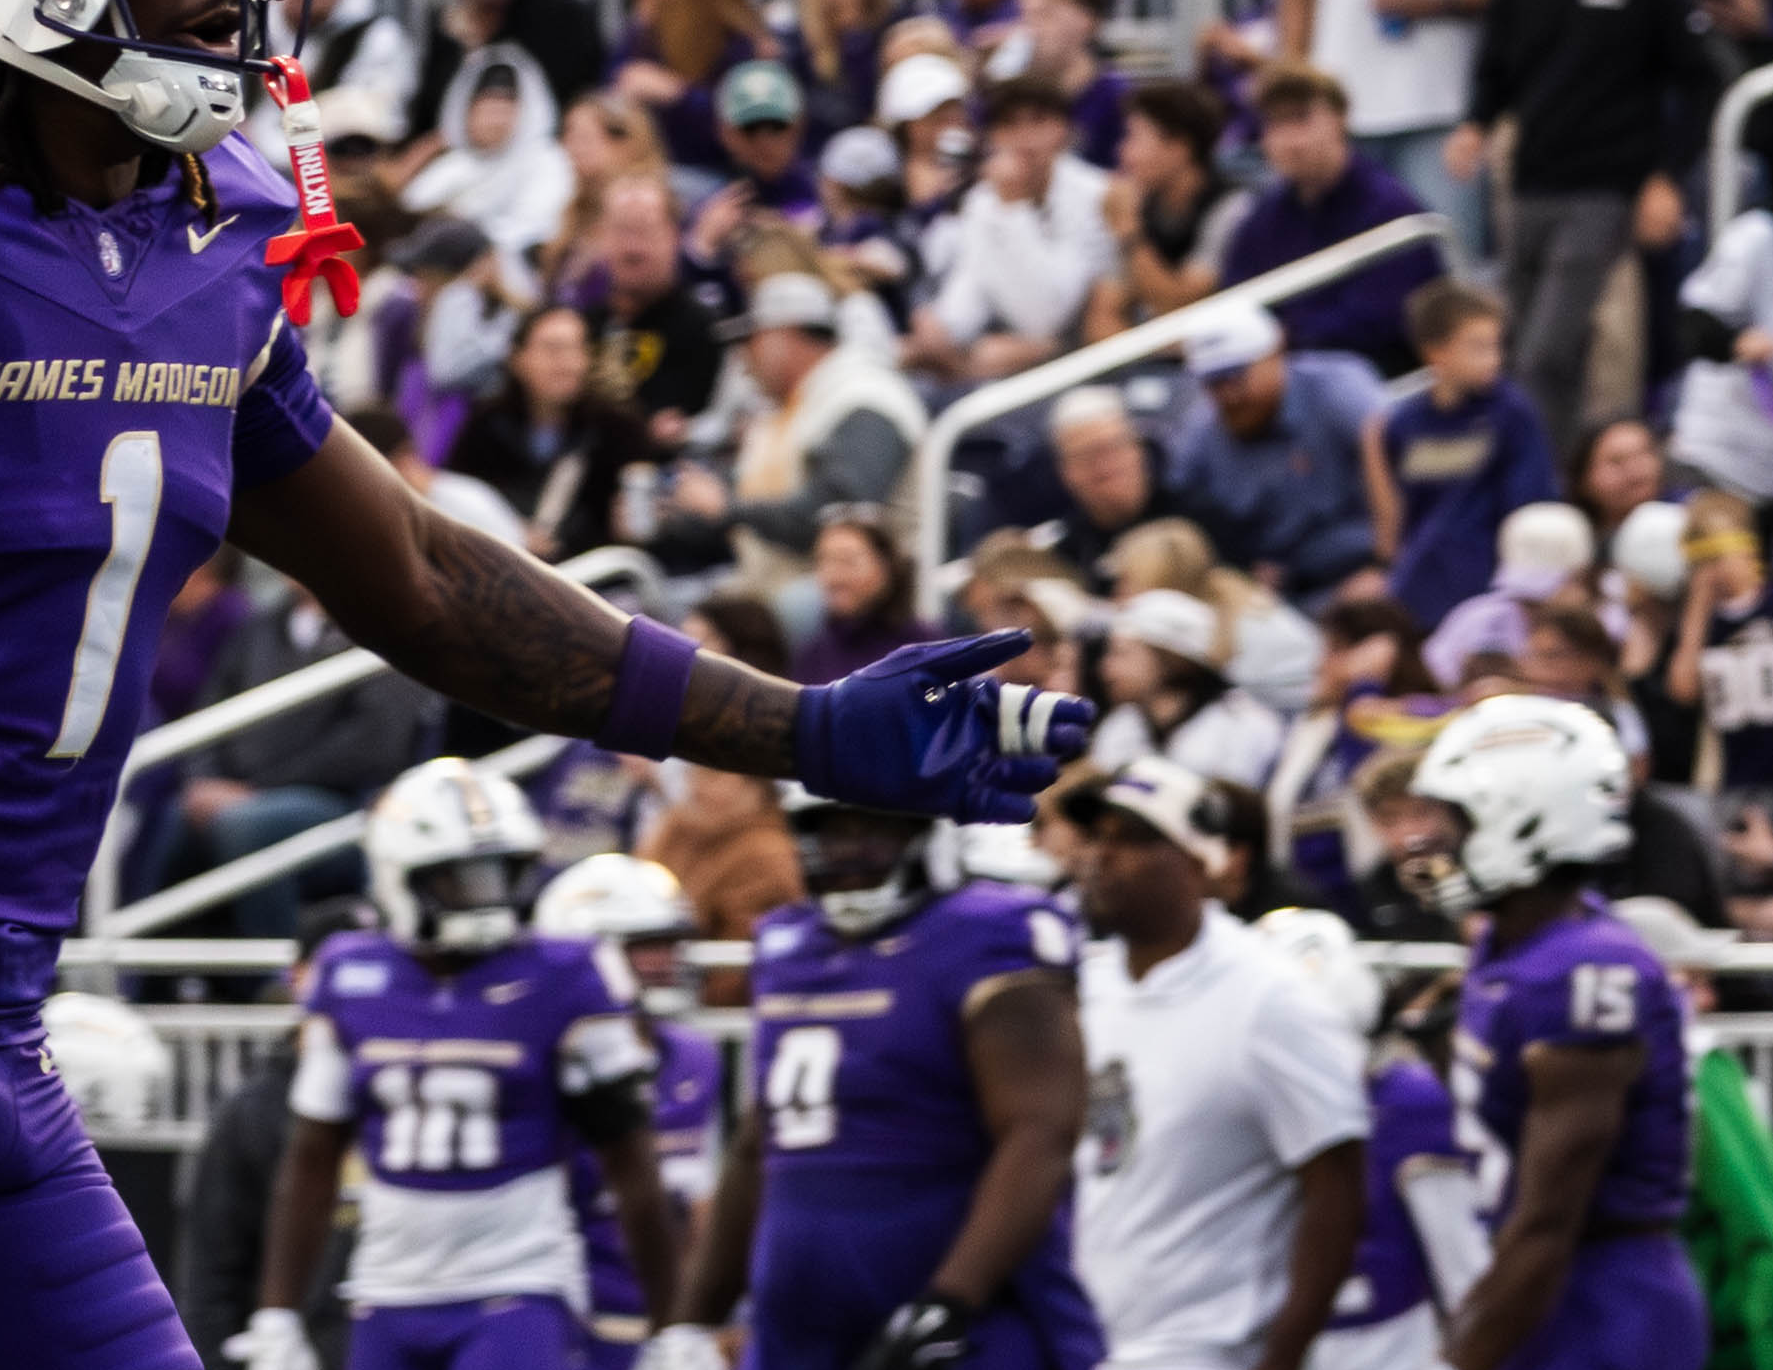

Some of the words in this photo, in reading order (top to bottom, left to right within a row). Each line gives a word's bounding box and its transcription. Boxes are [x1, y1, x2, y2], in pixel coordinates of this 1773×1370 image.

[294, 142, 334, 216] NXTRN
[44, 430, 164, 759] 1
[1570, 963, 1635, 1031] 15
